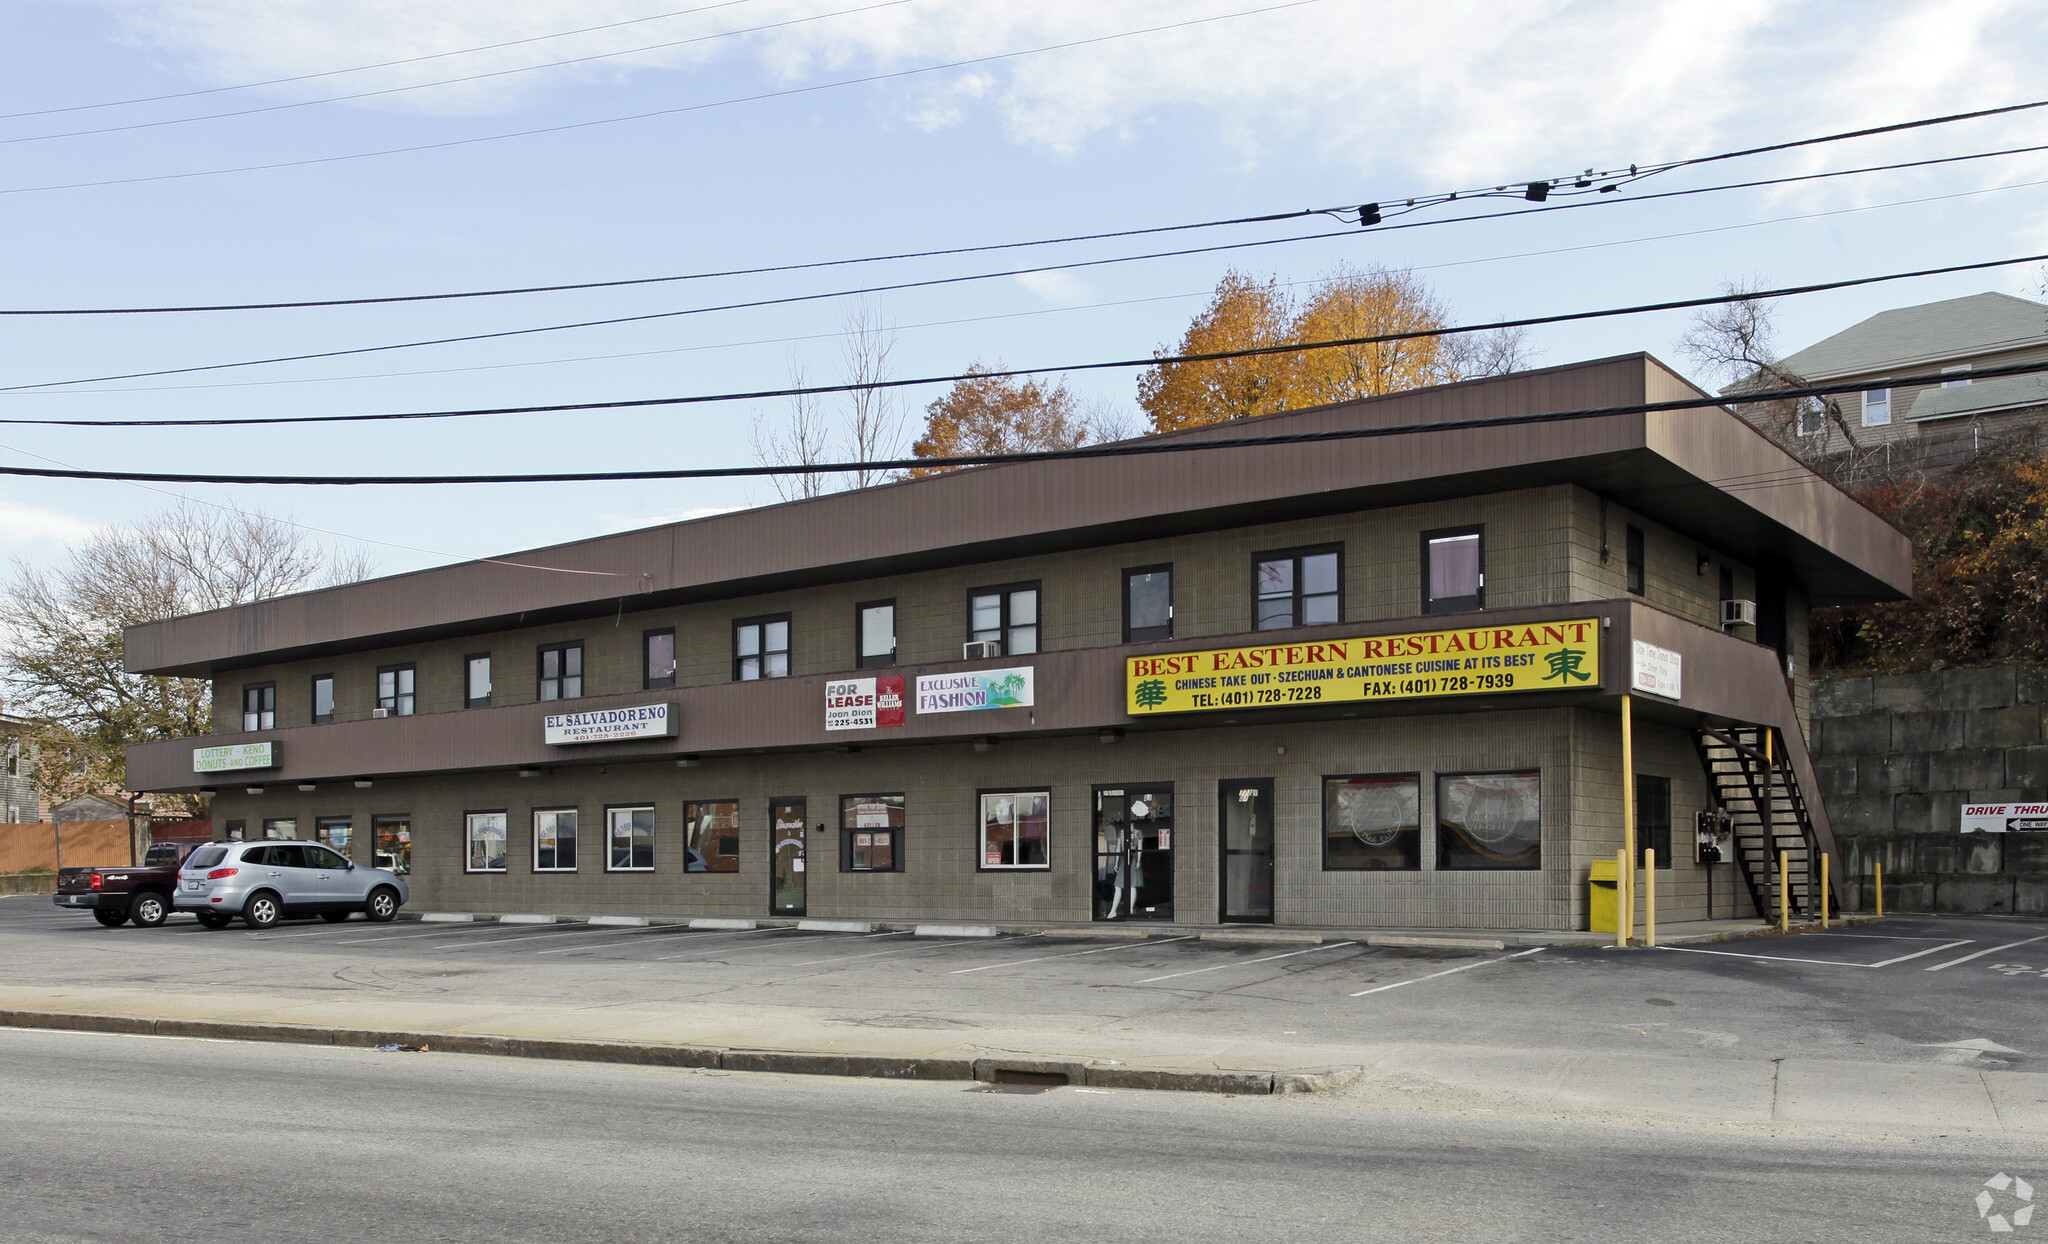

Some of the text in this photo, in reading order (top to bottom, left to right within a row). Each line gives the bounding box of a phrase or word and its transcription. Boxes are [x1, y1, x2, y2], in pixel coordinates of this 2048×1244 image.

[1133, 622, 1592, 678] BEST EASTERN RESTAURANT
[1175, 677, 1217, 690] CHINESE
[1220, 675, 1247, 687] TAKE
[1250, 673, 1271, 685] OUT
[1278, 668, 1334, 683] SZECHUAN
[1336, 667, 1345, 679] &
[1346, 662, 1413, 678] CANTONESE
[1416, 658, 1461, 673] CUISINE
[1463, 657, 1479, 669] AT
[1481, 656, 1501, 668] ITS
[1504, 653, 1536, 667] BEST
[1541, 647, 1592, 684] 東
[827, 684, 858, 697] FOR
[920, 676, 979, 692] EXCLUSIVE
[1364, 673, 1514, 696] FAX: (401) 728-7939
[827, 695, 873, 708] LEASE
[877, 700, 903, 709] WILLIAMS
[920, 691, 986, 710] FASHION
[1192, 686, 1322, 707] TEL: (401) 728-7228
[546, 706, 666, 728] EL SALVADORENO
[852, 709, 873, 717] Dion
[563, 722, 648, 736] RESTAURANT
[834, 718, 873, 727] 225-4531
[200, 747, 234, 758] LOTTERY
[243, 744, 265, 755] KENO
[196, 754, 271, 770] DONUTS AND COFFEE
[1965, 805, 2048, 816] DRIVE THRU
